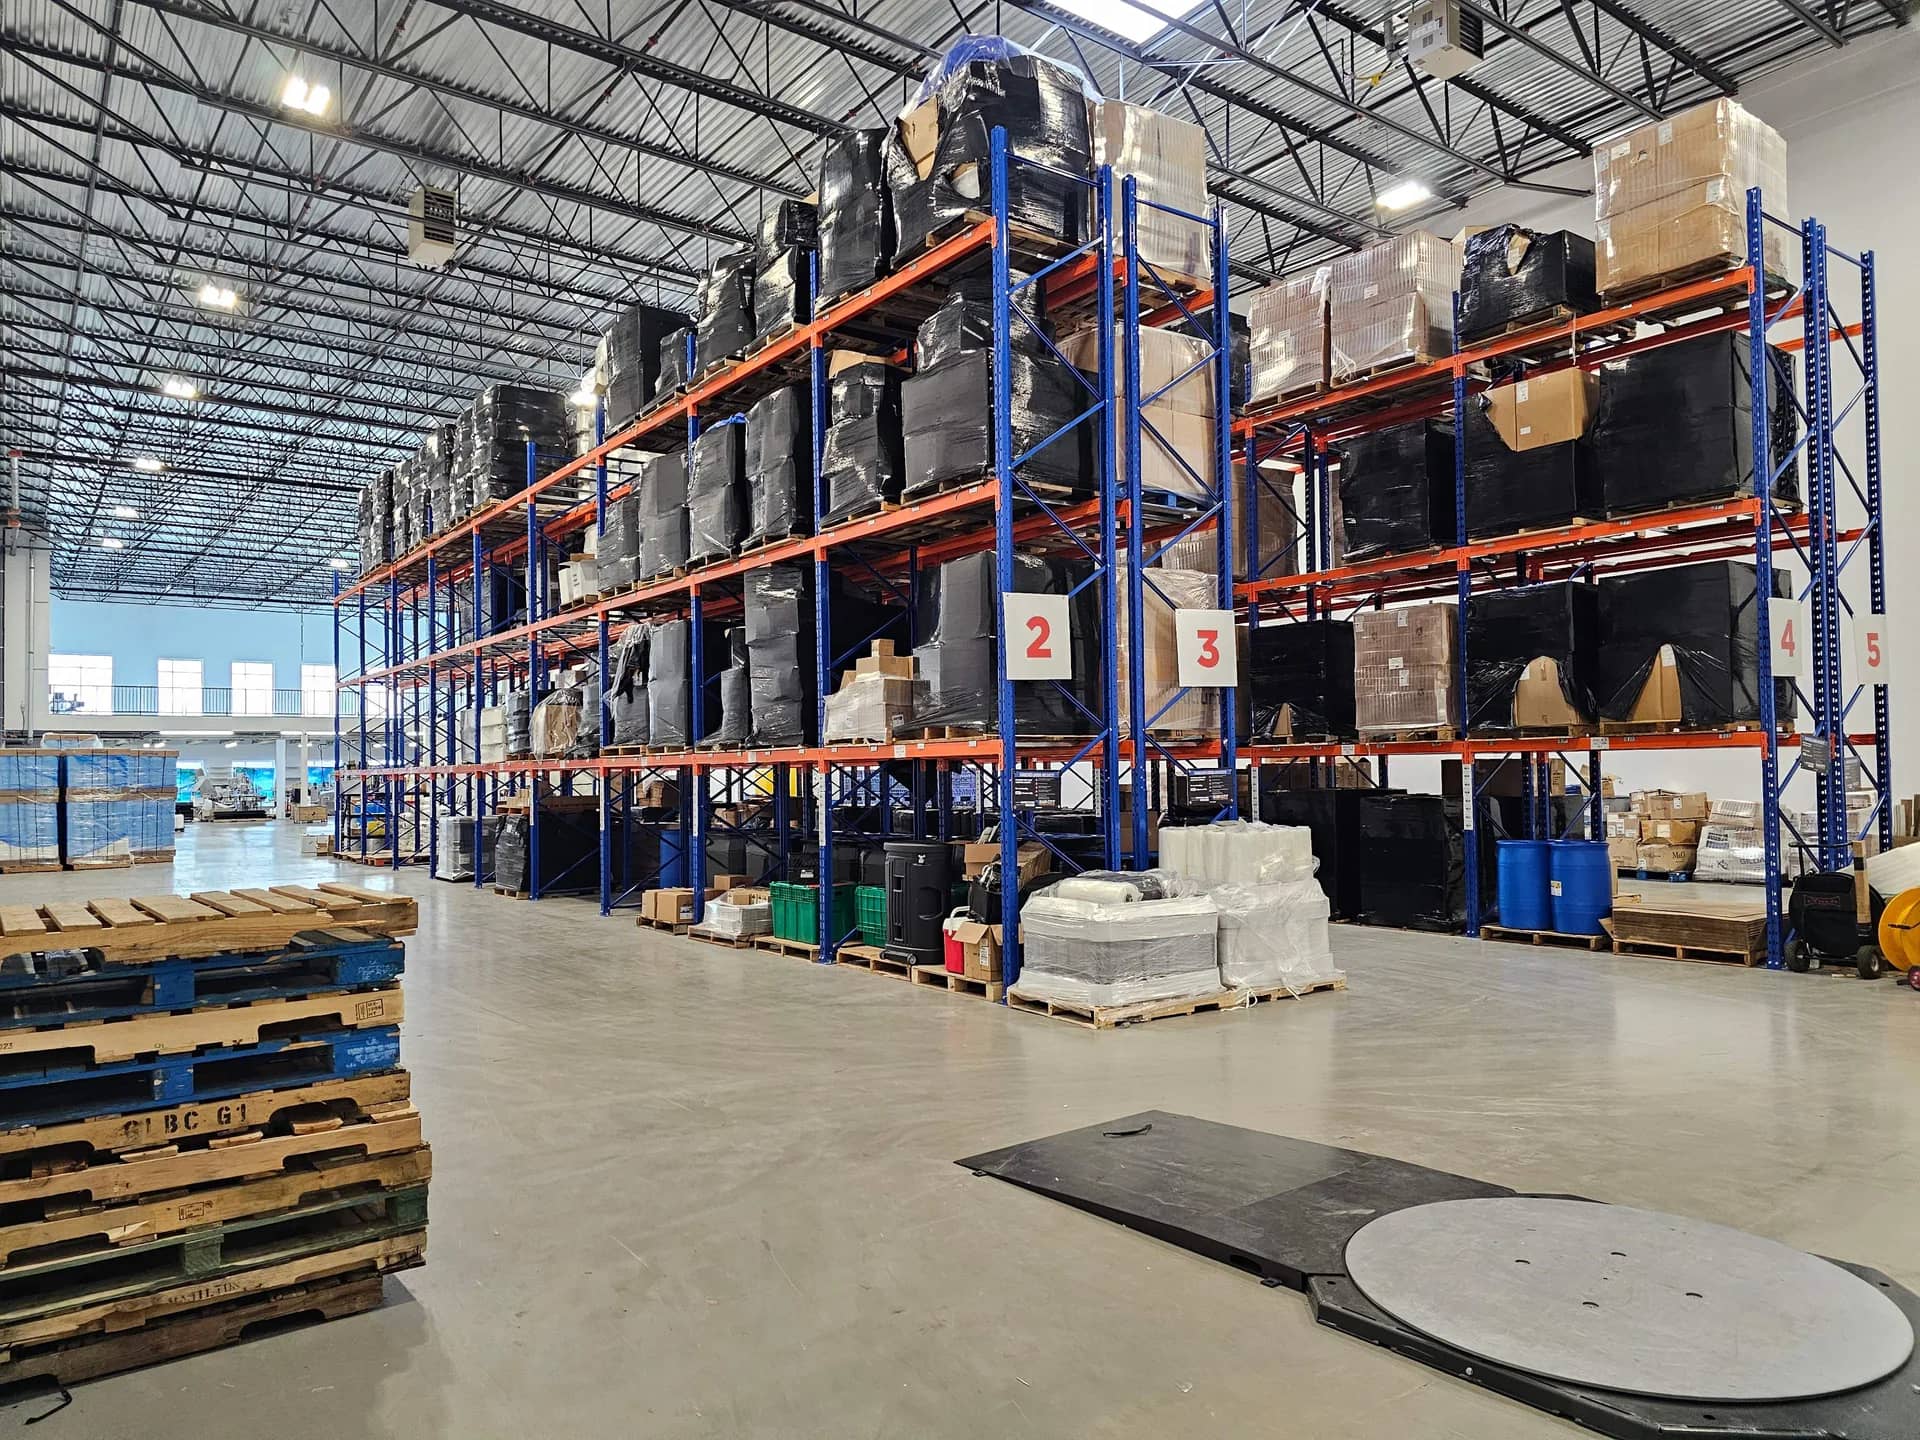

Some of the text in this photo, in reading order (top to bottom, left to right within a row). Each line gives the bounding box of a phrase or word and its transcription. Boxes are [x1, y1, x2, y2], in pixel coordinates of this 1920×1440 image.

[1026, 616, 1052, 658] 2
[1197, 629, 1220, 668] 3
[1780, 619, 1796, 657] 4
[1866, 632, 1881, 667] 5
[163, 1111, 199, 1134] BC
